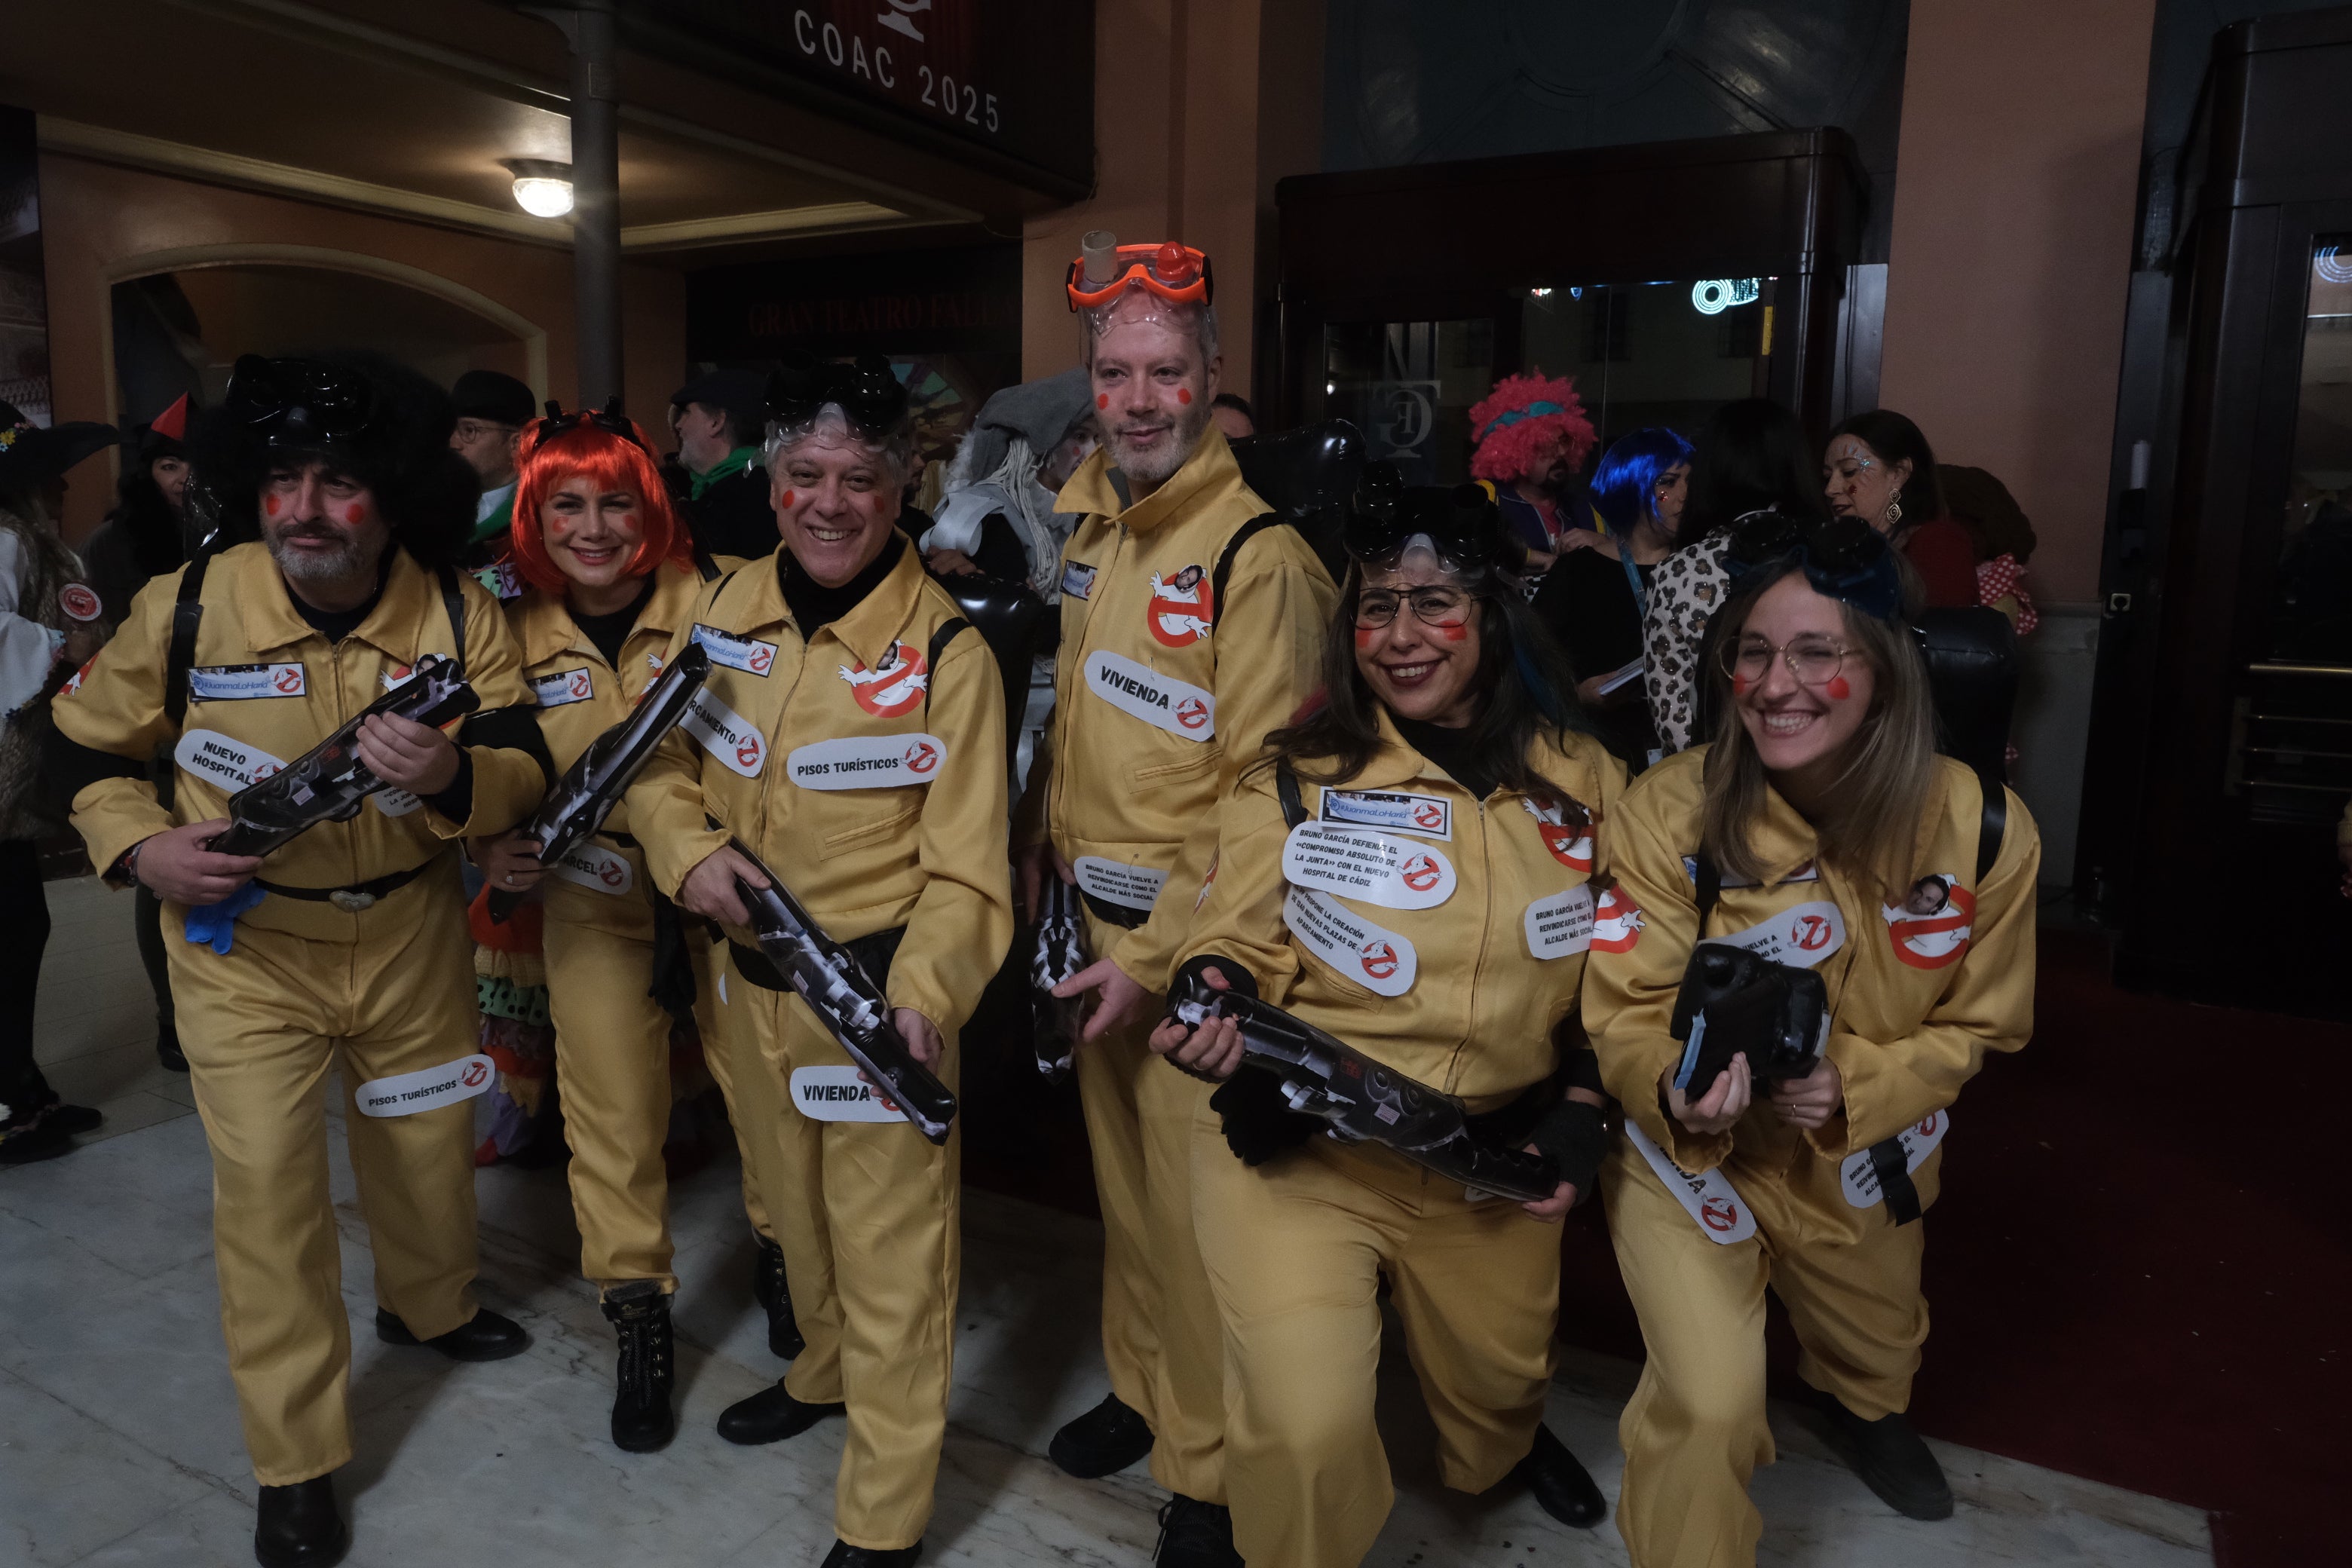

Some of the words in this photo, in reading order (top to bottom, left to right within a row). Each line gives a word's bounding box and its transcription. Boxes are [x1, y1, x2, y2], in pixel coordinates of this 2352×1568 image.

[794, 9, 896, 89] COAC
[918, 65, 999, 133] 2025
[748, 299, 815, 337] GRAN
[825, 293, 923, 332] TEATRO
[1101, 666, 1169, 709] VIVIENDA
[203, 741, 247, 765] NUEVO
[192, 754, 252, 785] HOSPITAL
[798, 764, 830, 776] PISOS
[834, 758, 899, 773] TURÍSTICOS
[1299, 829, 1322, 839] BRUNO
[1324, 835, 1350, 844] GARCÍA
[1294, 853, 1304, 862] LA
[1337, 861, 1352, 870] CON
[1353, 864, 1362, 872] EL
[1364, 866, 1390, 878] NUEVO
[1346, 850, 1385, 864] ABSOLUTO
[1386, 858, 1396, 867] DE
[1086, 864, 1104, 874] BRUNO
[1105, 869, 1127, 880] GARCÍA
[1129, 874, 1151, 884] VUELVE
[1087, 873, 1129, 889] REIVINDICARSE
[1131, 884, 1147, 892] COMO
[1303, 868, 1335, 880] HOSPITAL
[1349, 876, 1371, 887] CÁDIZ
[1092, 884, 1116, 894] ALCALDE
[1133, 893, 1154, 901] SOCIAL
[1304, 893, 1325, 914] PROPONE
[1324, 911, 1332, 920] LA
[1332, 917, 1365, 940] CREACIÓN
[1536, 909, 1554, 920] BRUNO
[1555, 903, 1573, 916] GARCÍA
[1291, 894, 1297, 903] DE
[1304, 908, 1323, 928] NUEVAS
[1323, 924, 1347, 945] PLAZAS
[1347, 940, 1358, 950] DE
[1539, 917, 1576, 933] REIVINDICARSE
[1296, 916, 1334, 950] APARCAMIENTO
[1545, 933, 1568, 945] ALCALDE
[1569, 928, 1579, 939] MÁS
[1771, 946, 1782, 954] EL
[368, 1095, 397, 1107] PISOS
[401, 1080, 457, 1101] TURÍSTICOS
[803, 1086, 871, 1101] VIVIENDA
[1849, 1162, 1867, 1181] BRUNO
